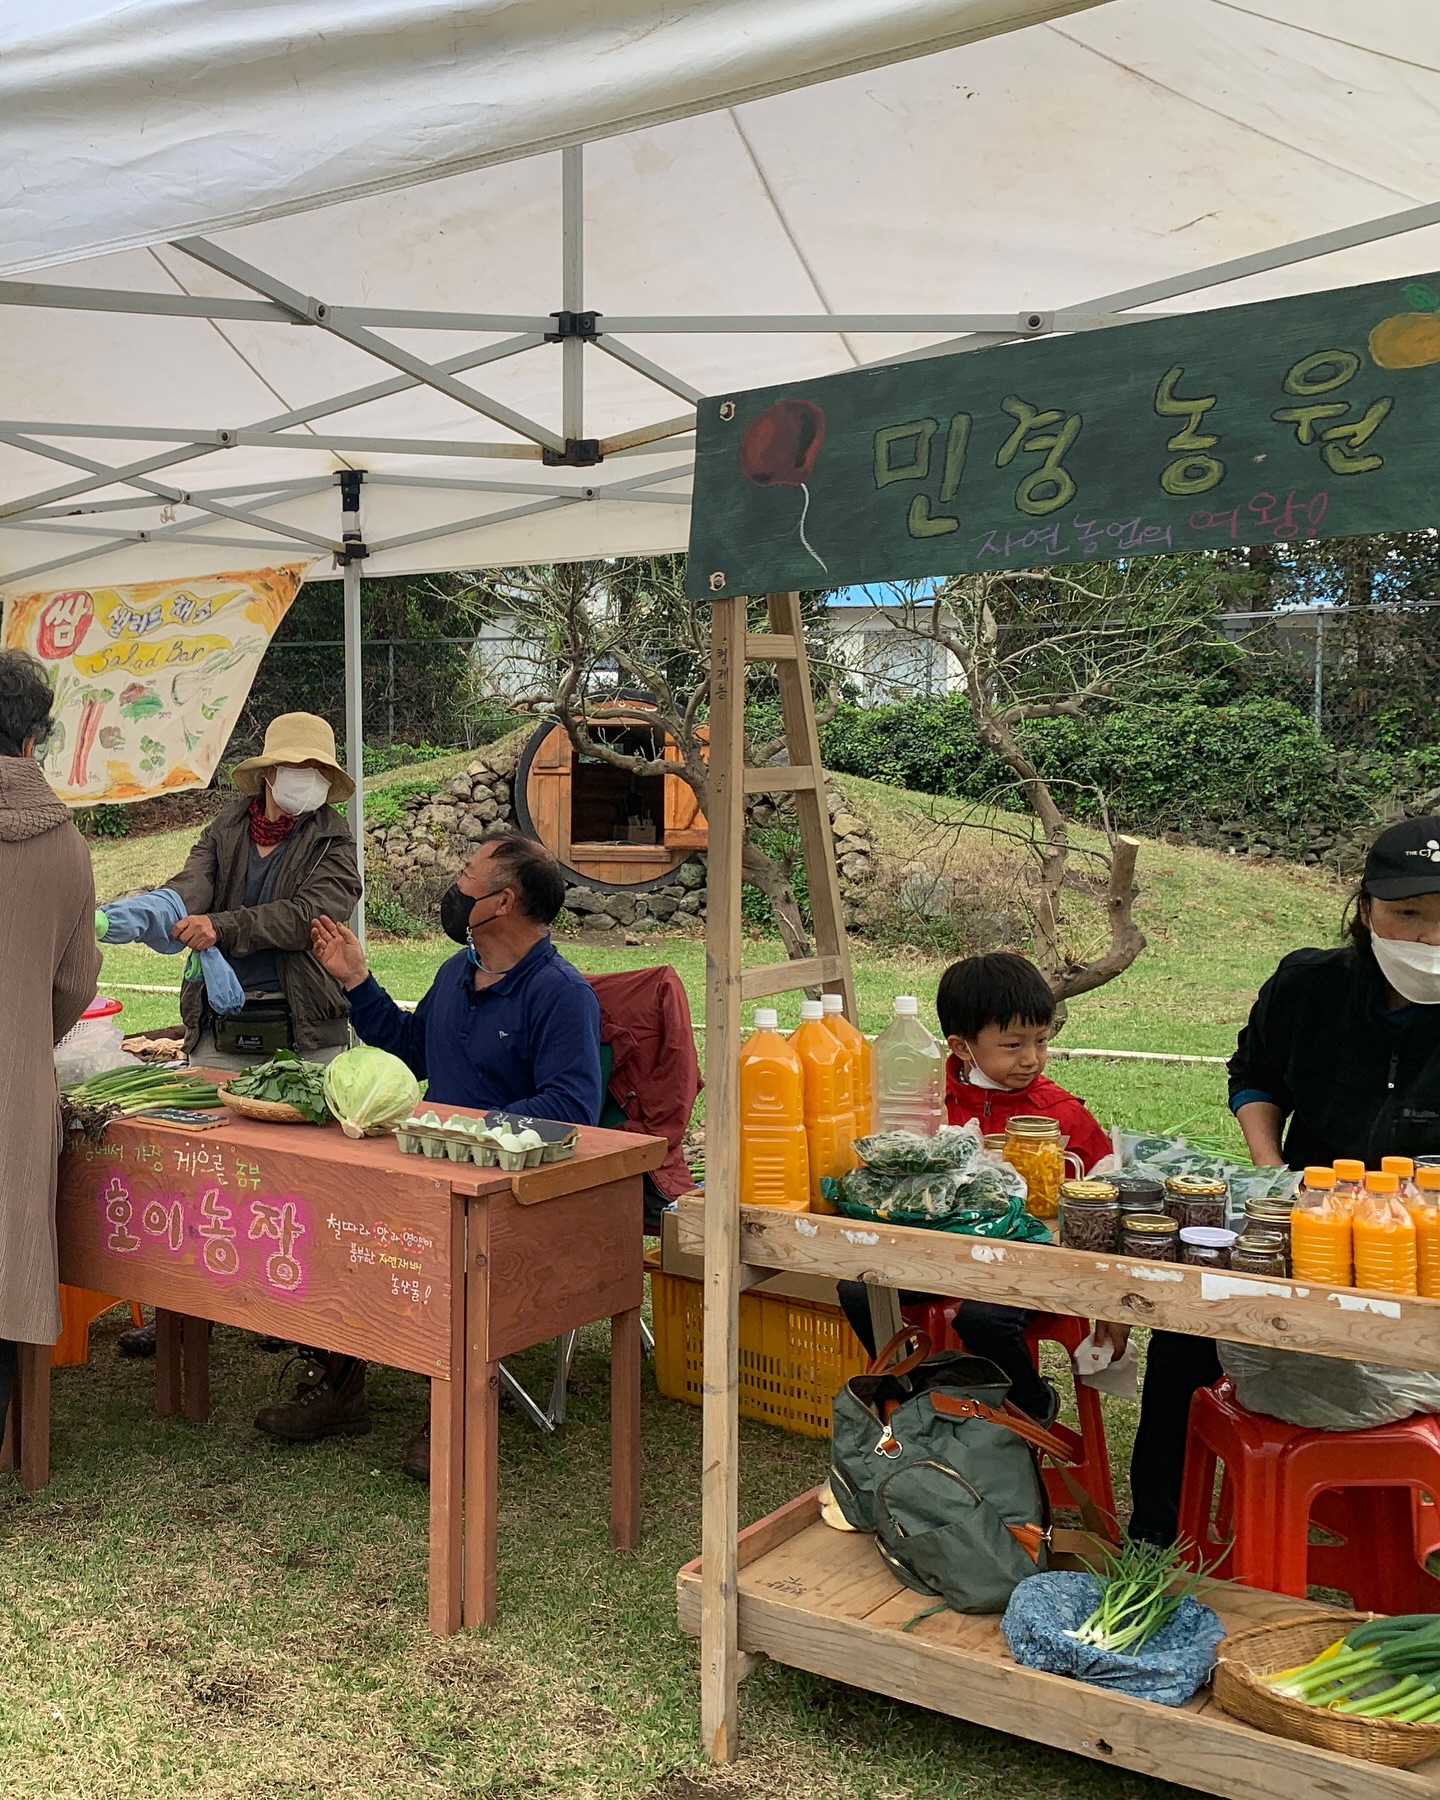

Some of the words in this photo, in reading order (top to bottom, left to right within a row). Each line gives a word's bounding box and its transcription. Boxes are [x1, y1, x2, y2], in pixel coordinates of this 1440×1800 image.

[45, 594, 89, 649] 쌈
[107, 603, 164, 639] 샐러드
[91, 643, 159, 674] Salad
[165, 640, 205, 664] Bar
[236, 1158, 261, 1190] 농부
[326, 1213, 371, 1240] 철따라
[350, 1242, 376, 1265] 풍부한
